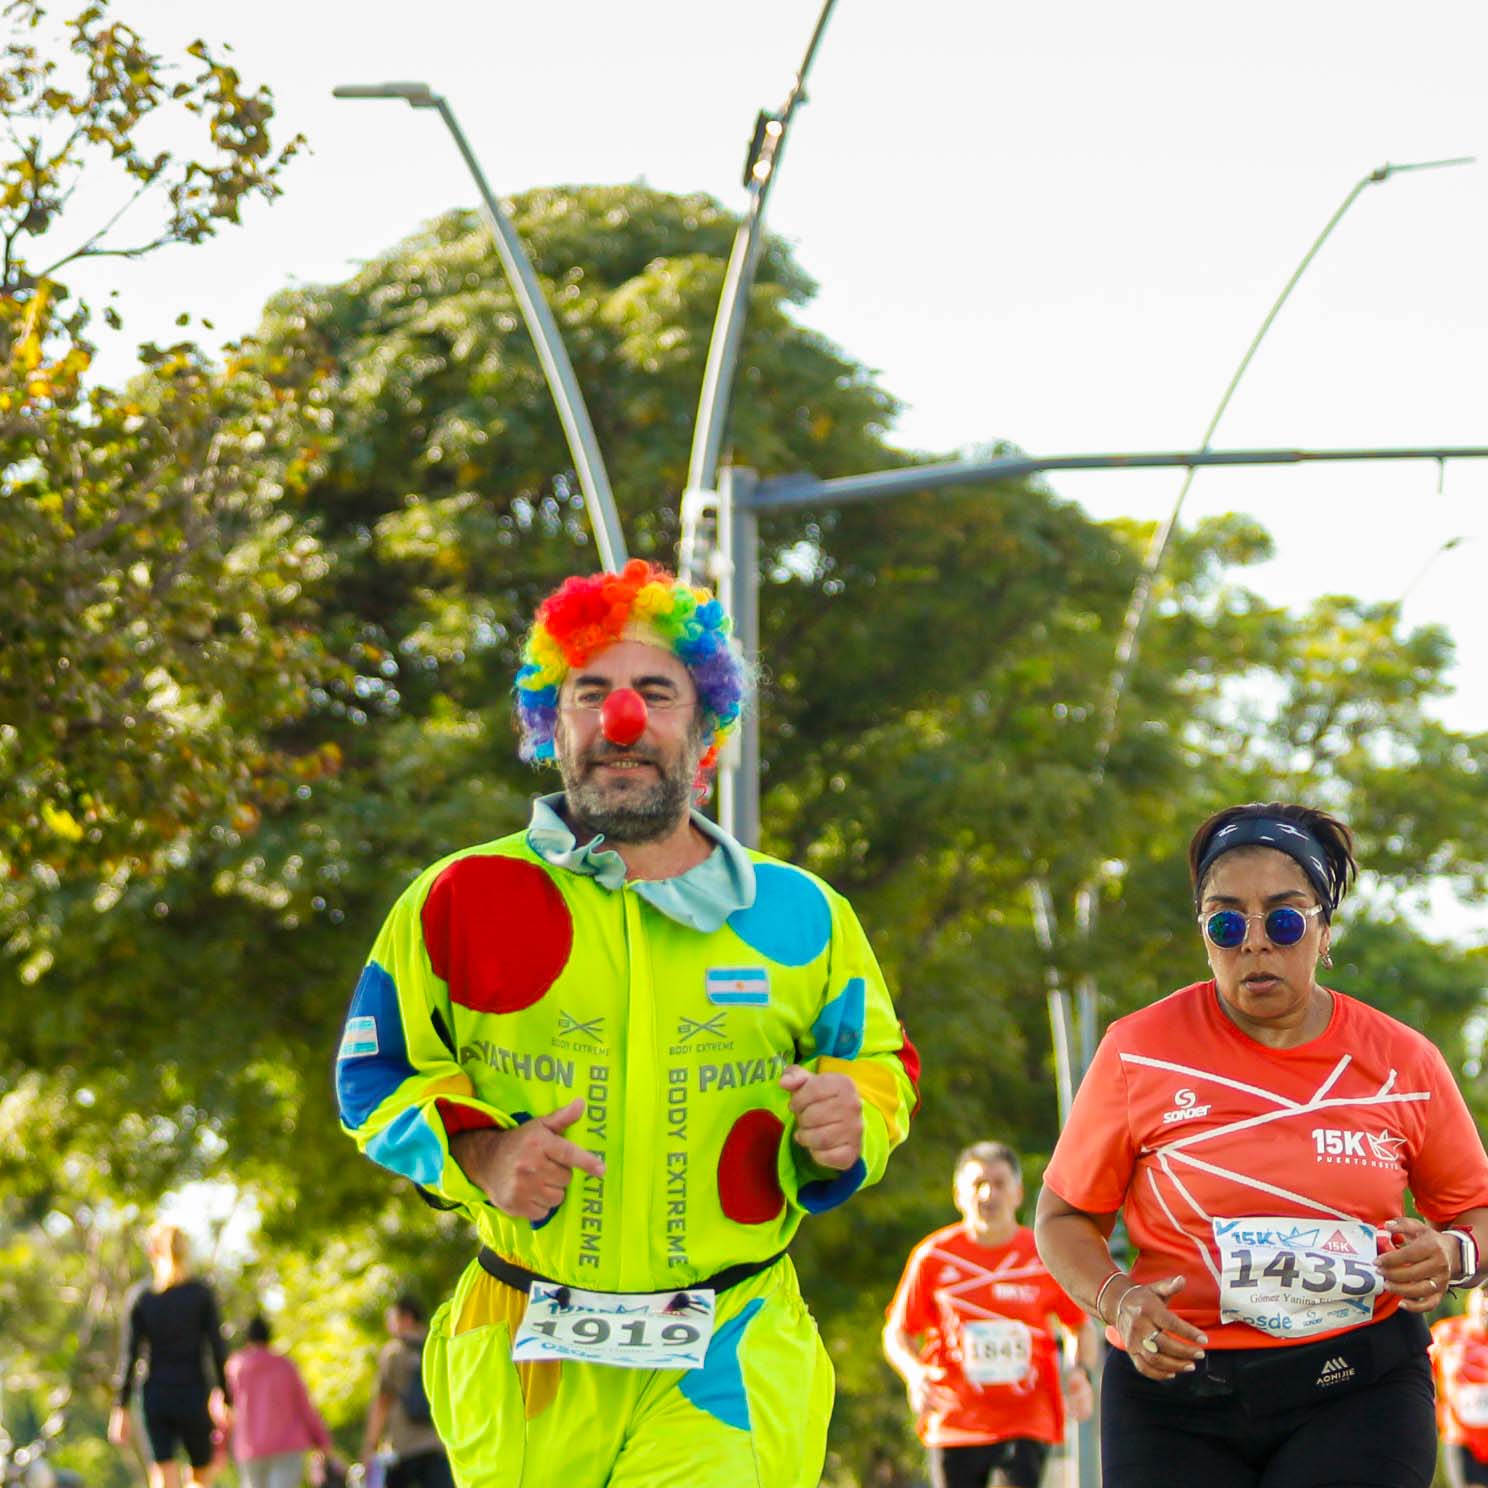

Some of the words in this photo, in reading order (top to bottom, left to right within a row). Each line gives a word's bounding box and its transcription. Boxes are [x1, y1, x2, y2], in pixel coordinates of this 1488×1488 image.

[669, 1046, 692, 1056] BODY
[696, 1041, 734, 1054] EXTREME
[587, 1065, 609, 1140] BODY
[668, 1068, 688, 1140] BODY
[1312, 1129, 1366, 1156] 15K
[1317, 1156, 1367, 1166] PUERTO
[667, 1152, 689, 1269] EXTREME
[1231, 1231, 1277, 1246] 15K
[1327, 1241, 1351, 1252] 15K
[1230, 1249, 1376, 1296] 1435
[532, 1318, 701, 1348] 1919
